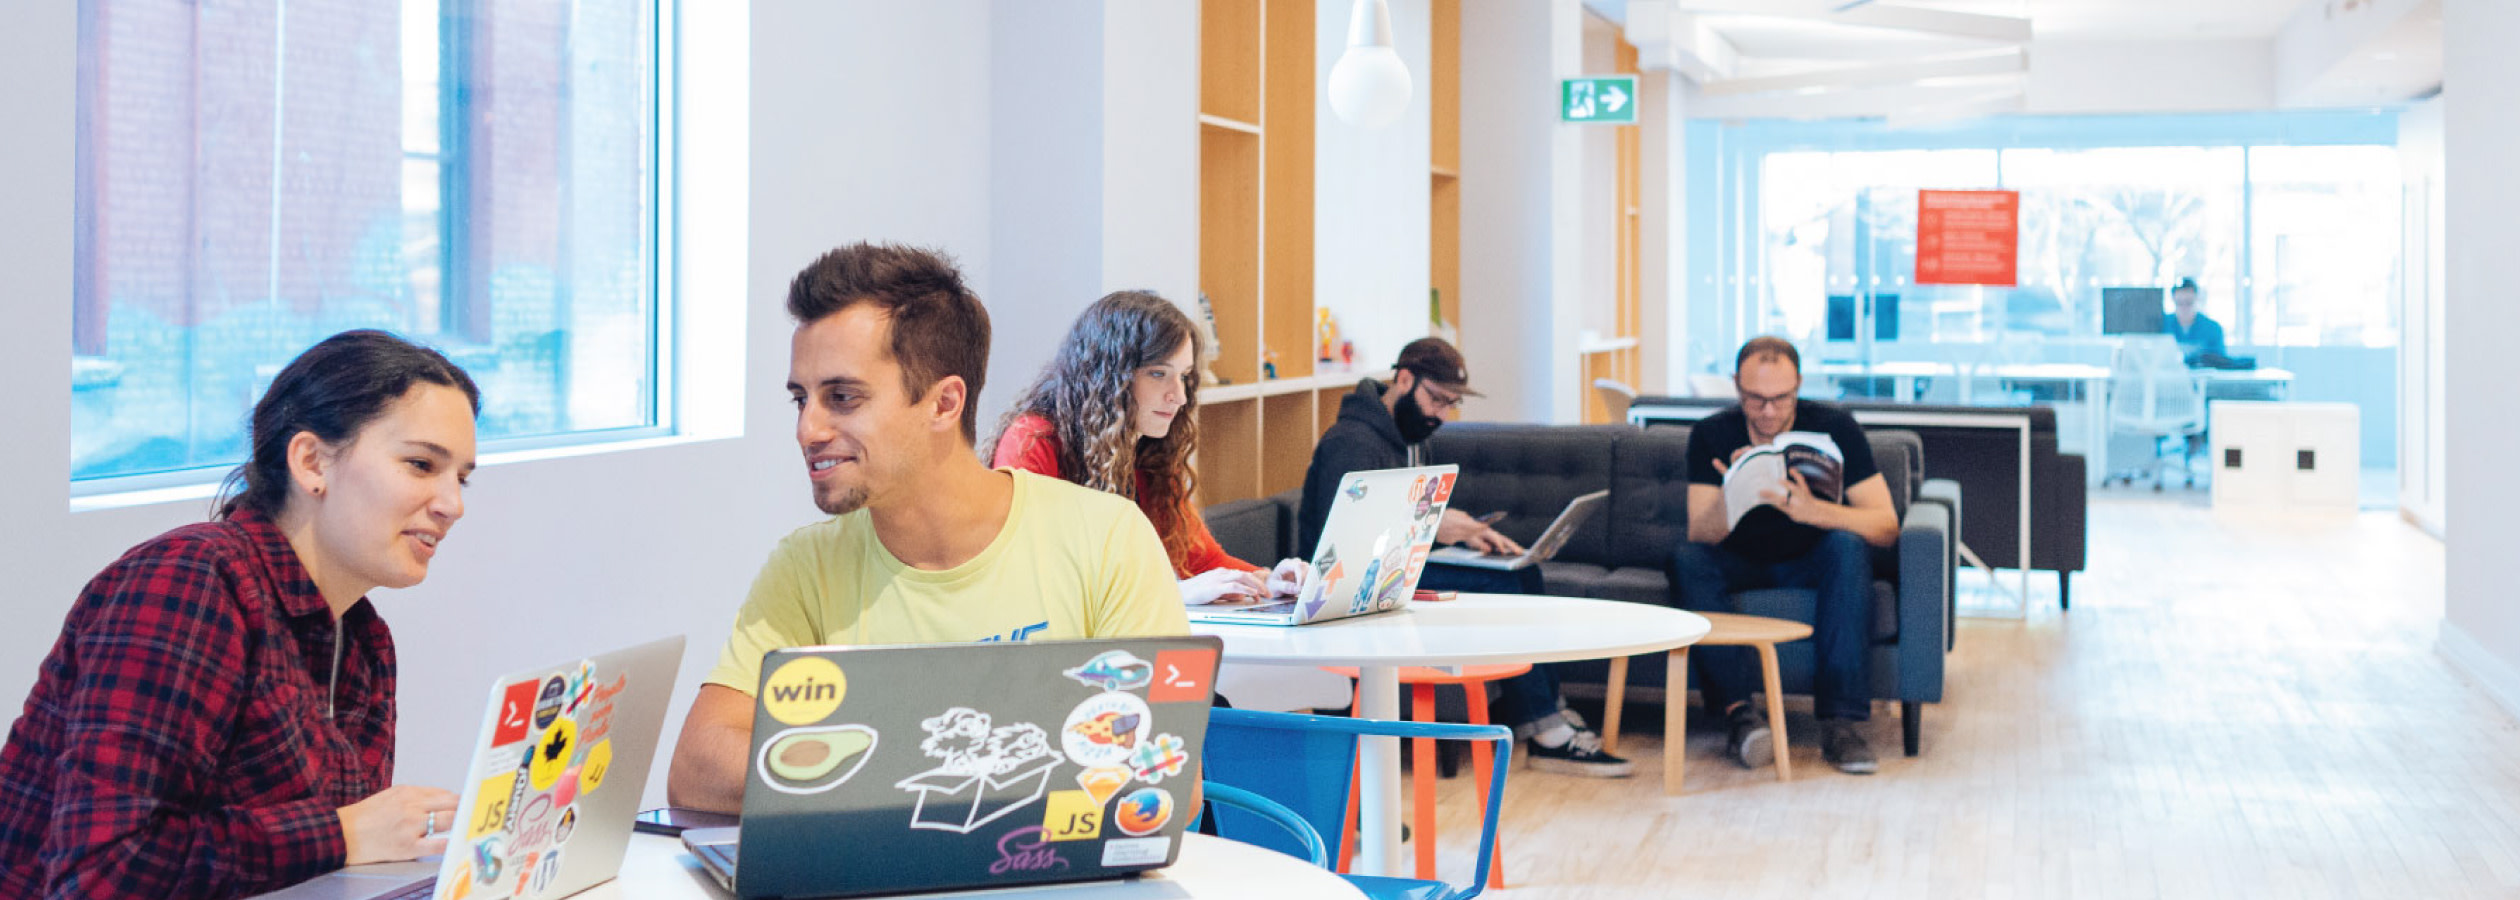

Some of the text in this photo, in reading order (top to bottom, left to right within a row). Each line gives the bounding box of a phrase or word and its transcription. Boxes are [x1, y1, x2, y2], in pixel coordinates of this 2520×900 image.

[773, 676, 836, 702] win
[477, 799, 504, 833] JS
[1058, 811, 1096, 836] JS
[989, 825, 1070, 875] Sass
